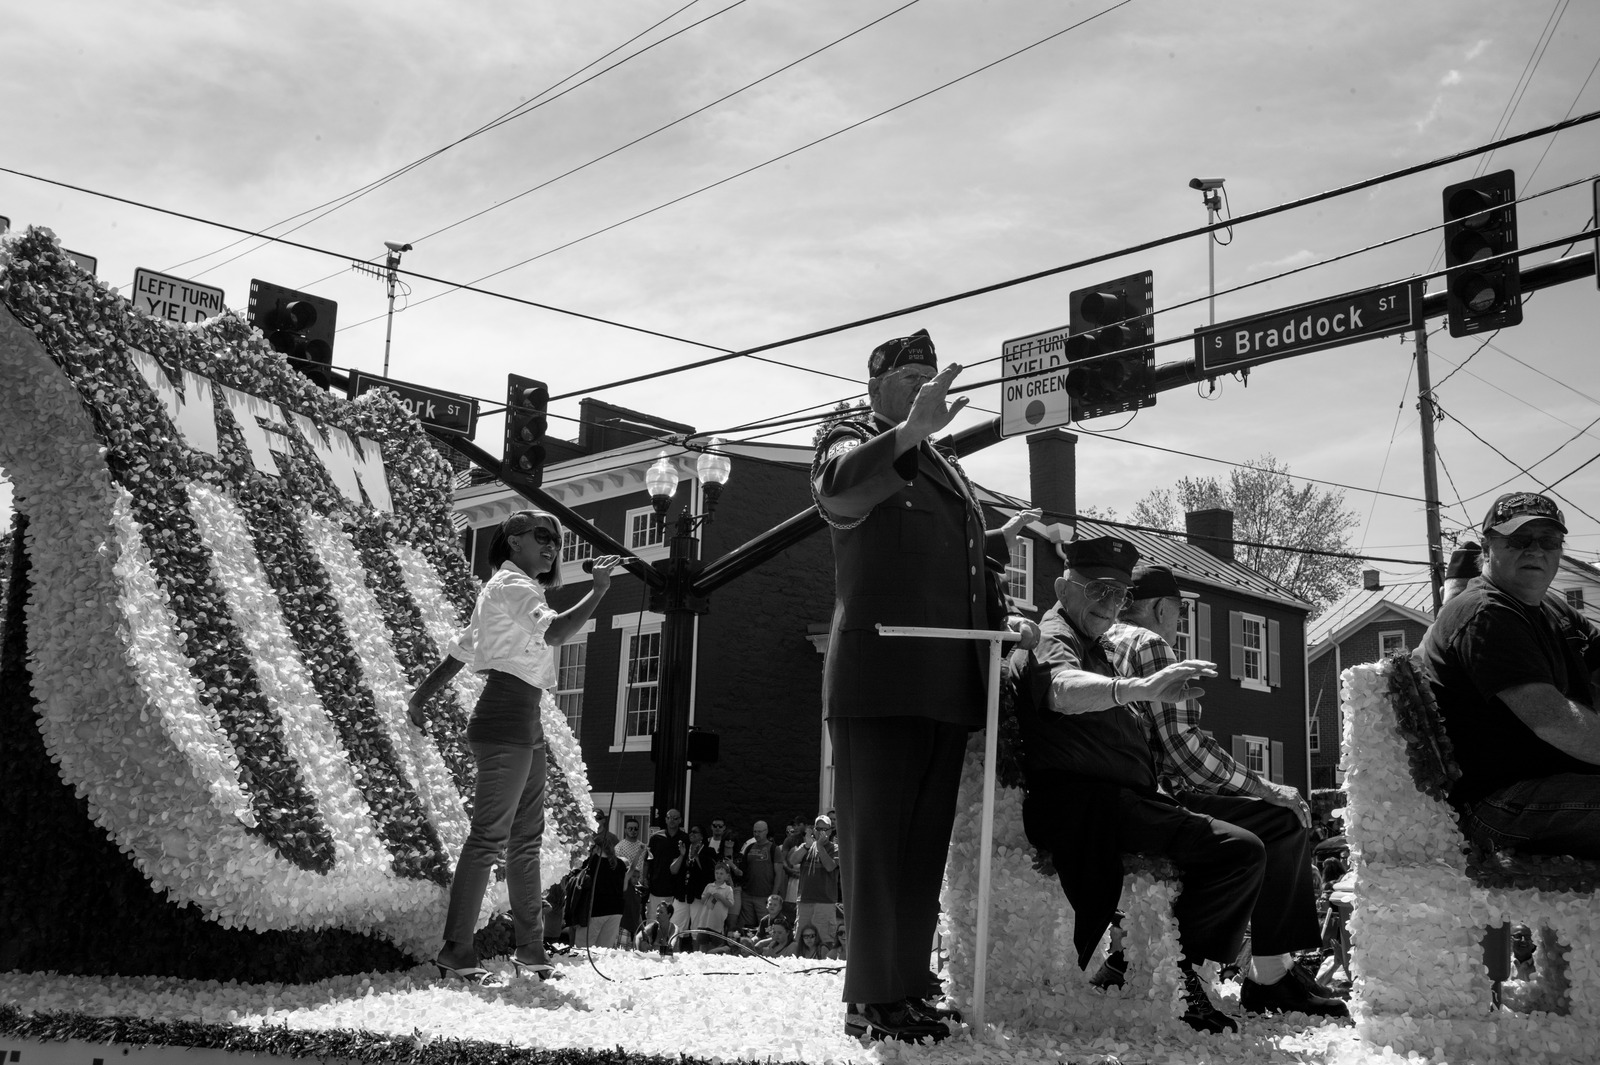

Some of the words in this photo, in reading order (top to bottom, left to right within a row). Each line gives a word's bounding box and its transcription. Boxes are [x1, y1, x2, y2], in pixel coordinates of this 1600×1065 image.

[138, 275, 177, 299] LEFT
[181, 286, 220, 311] TURN
[1214, 335, 1224, 349] S
[1235, 305, 1363, 355] Braddock
[1378, 295, 1397, 311] ST
[1006, 341, 1034, 363] LEFT
[1037, 332, 1068, 355] TURN
[1007, 384, 1023, 402] ON
[1026, 374, 1066, 398] GREEN
[447, 404, 461, 416] ST
[128, 344, 395, 515] VFW
